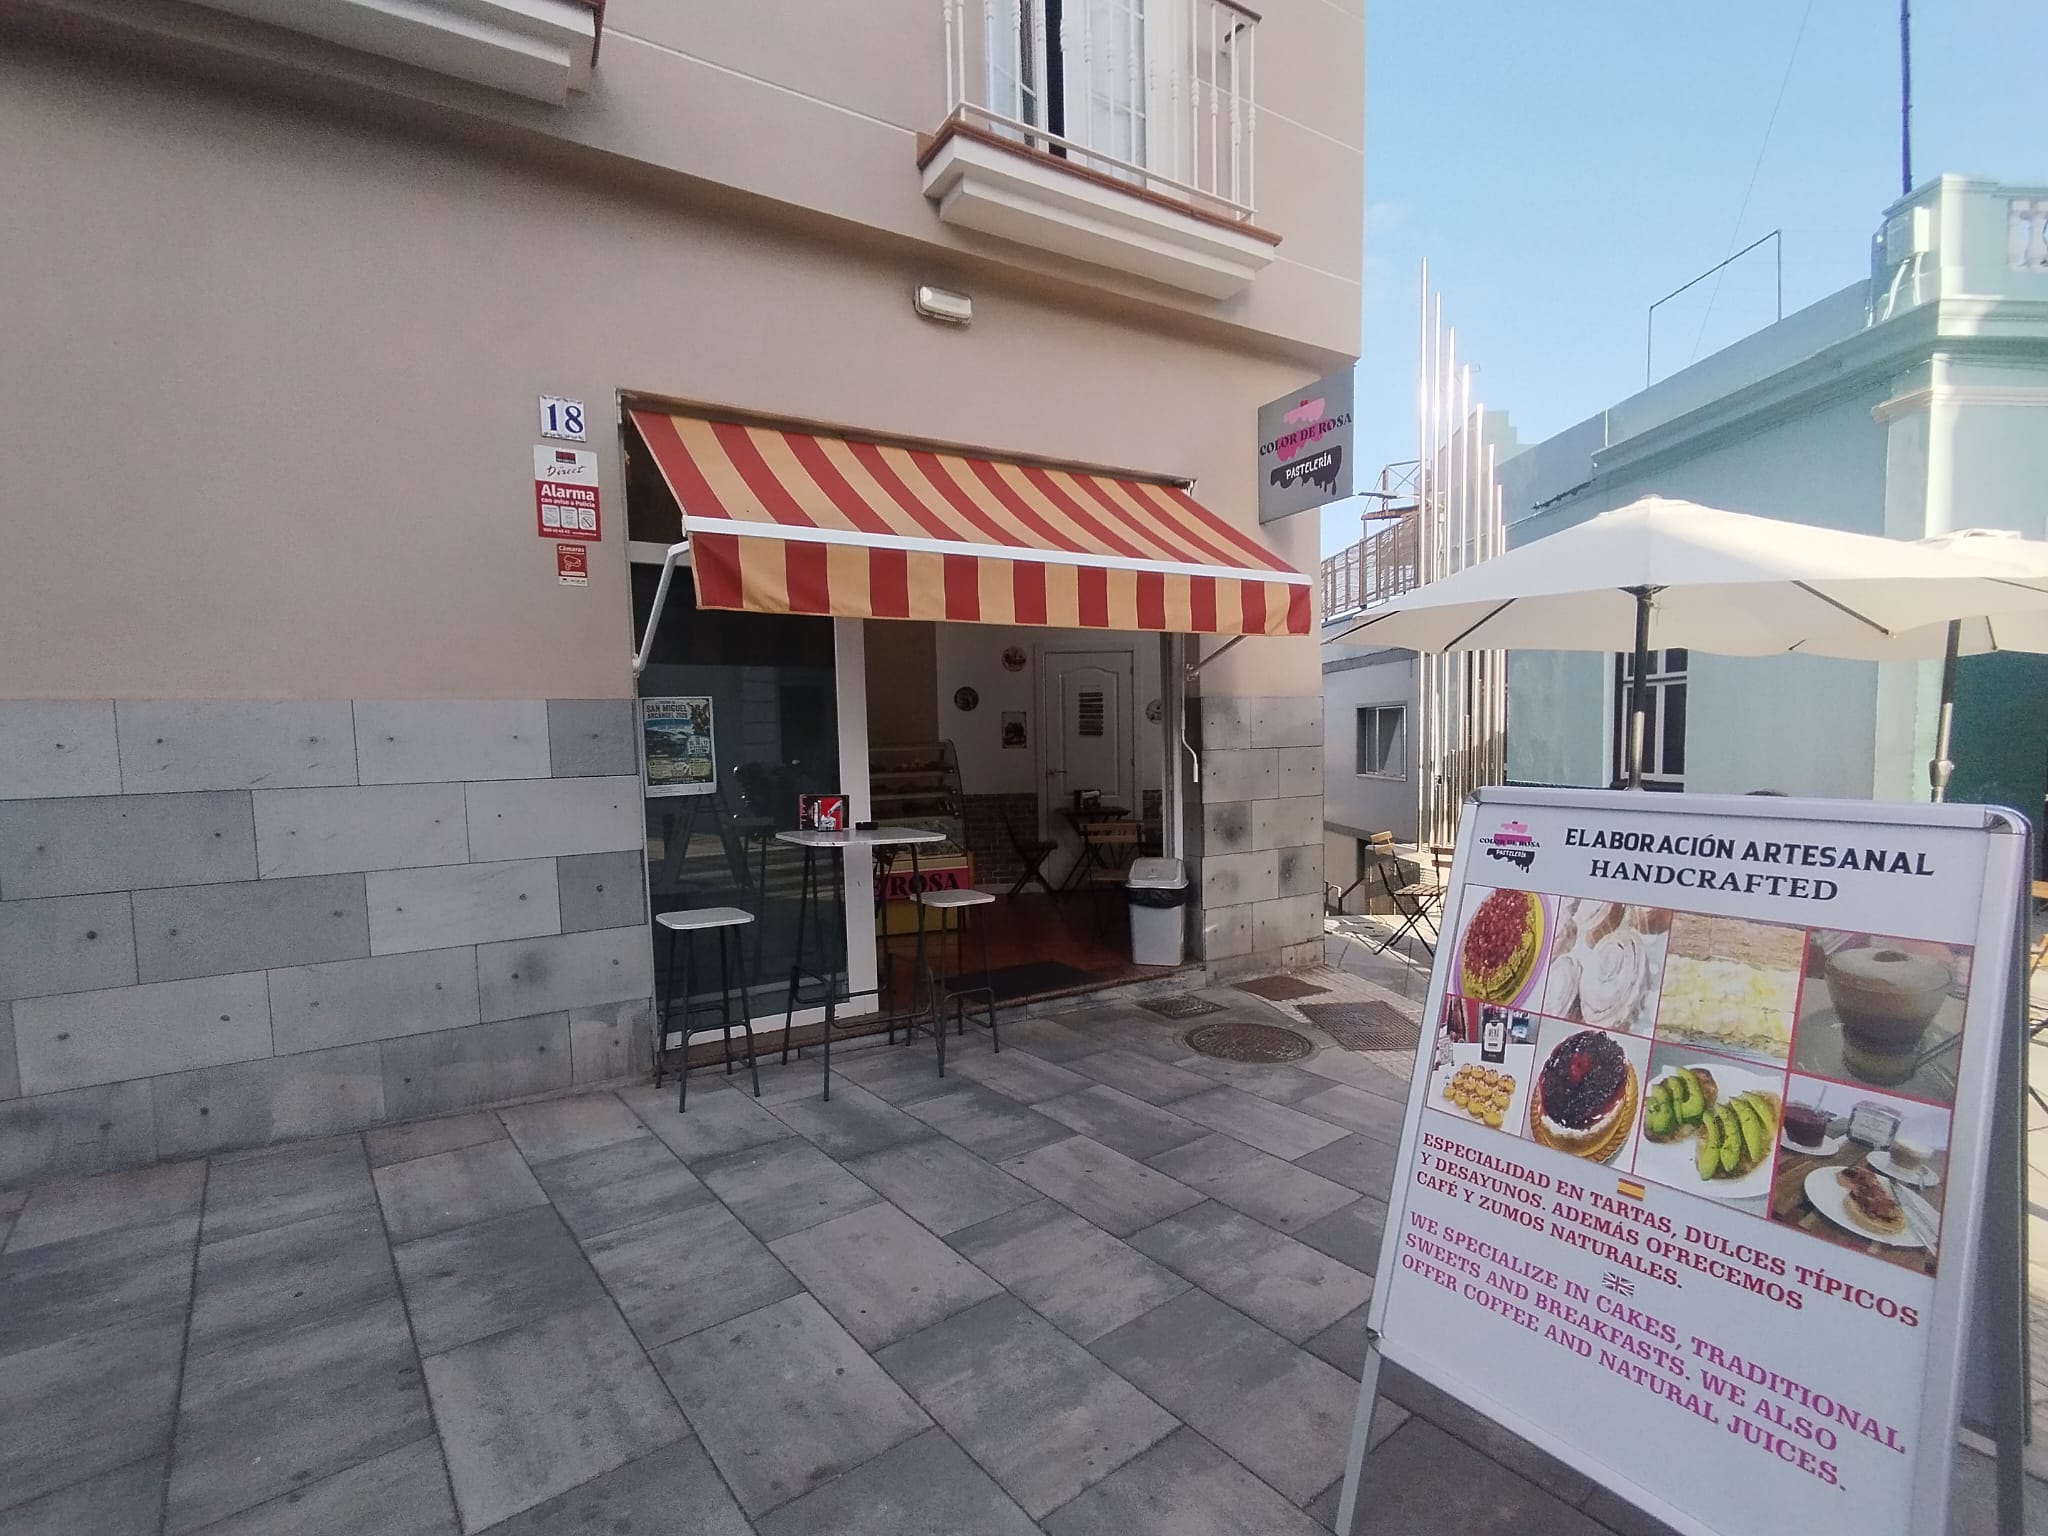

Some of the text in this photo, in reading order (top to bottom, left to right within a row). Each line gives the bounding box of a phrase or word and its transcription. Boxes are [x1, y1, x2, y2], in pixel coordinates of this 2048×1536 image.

[547, 403, 584, 434] 18
[1259, 413, 1352, 456] COLOR DE ROSA
[547, 465, 586, 477] Direct
[1285, 452, 1332, 480] PASTELERÍA
[541, 484, 595, 502] Alarma
[646, 704, 688, 713] SAN MIGUEL
[1564, 827, 1935, 876] ELABORACIÓN ARTESANAL
[889, 872, 960, 896] ROSA
[1590, 859, 1838, 900] HANDCRAFTED
[1416, 1170, 1683, 1289] CAFÉ Y ZUMOS NATURALES.
[1420, 1151, 1803, 1311] Y DESAYUNOS. ADEMÁS OFRECEMOS
[1423, 1132, 1919, 1327] ESPECIALIDAD EN TARTAS, DULCES TÍPICOS
[1405, 1232, 1837, 1451] SWEETS AND BREAKFASTS. WE ALSO
[1410, 1211, 1906, 1454] WE SPECIALIZE IN CAKES, TRADITIONAL
[1402, 1254, 1846, 1491] OFFER COFFEE AND NATURAL JUICES.
